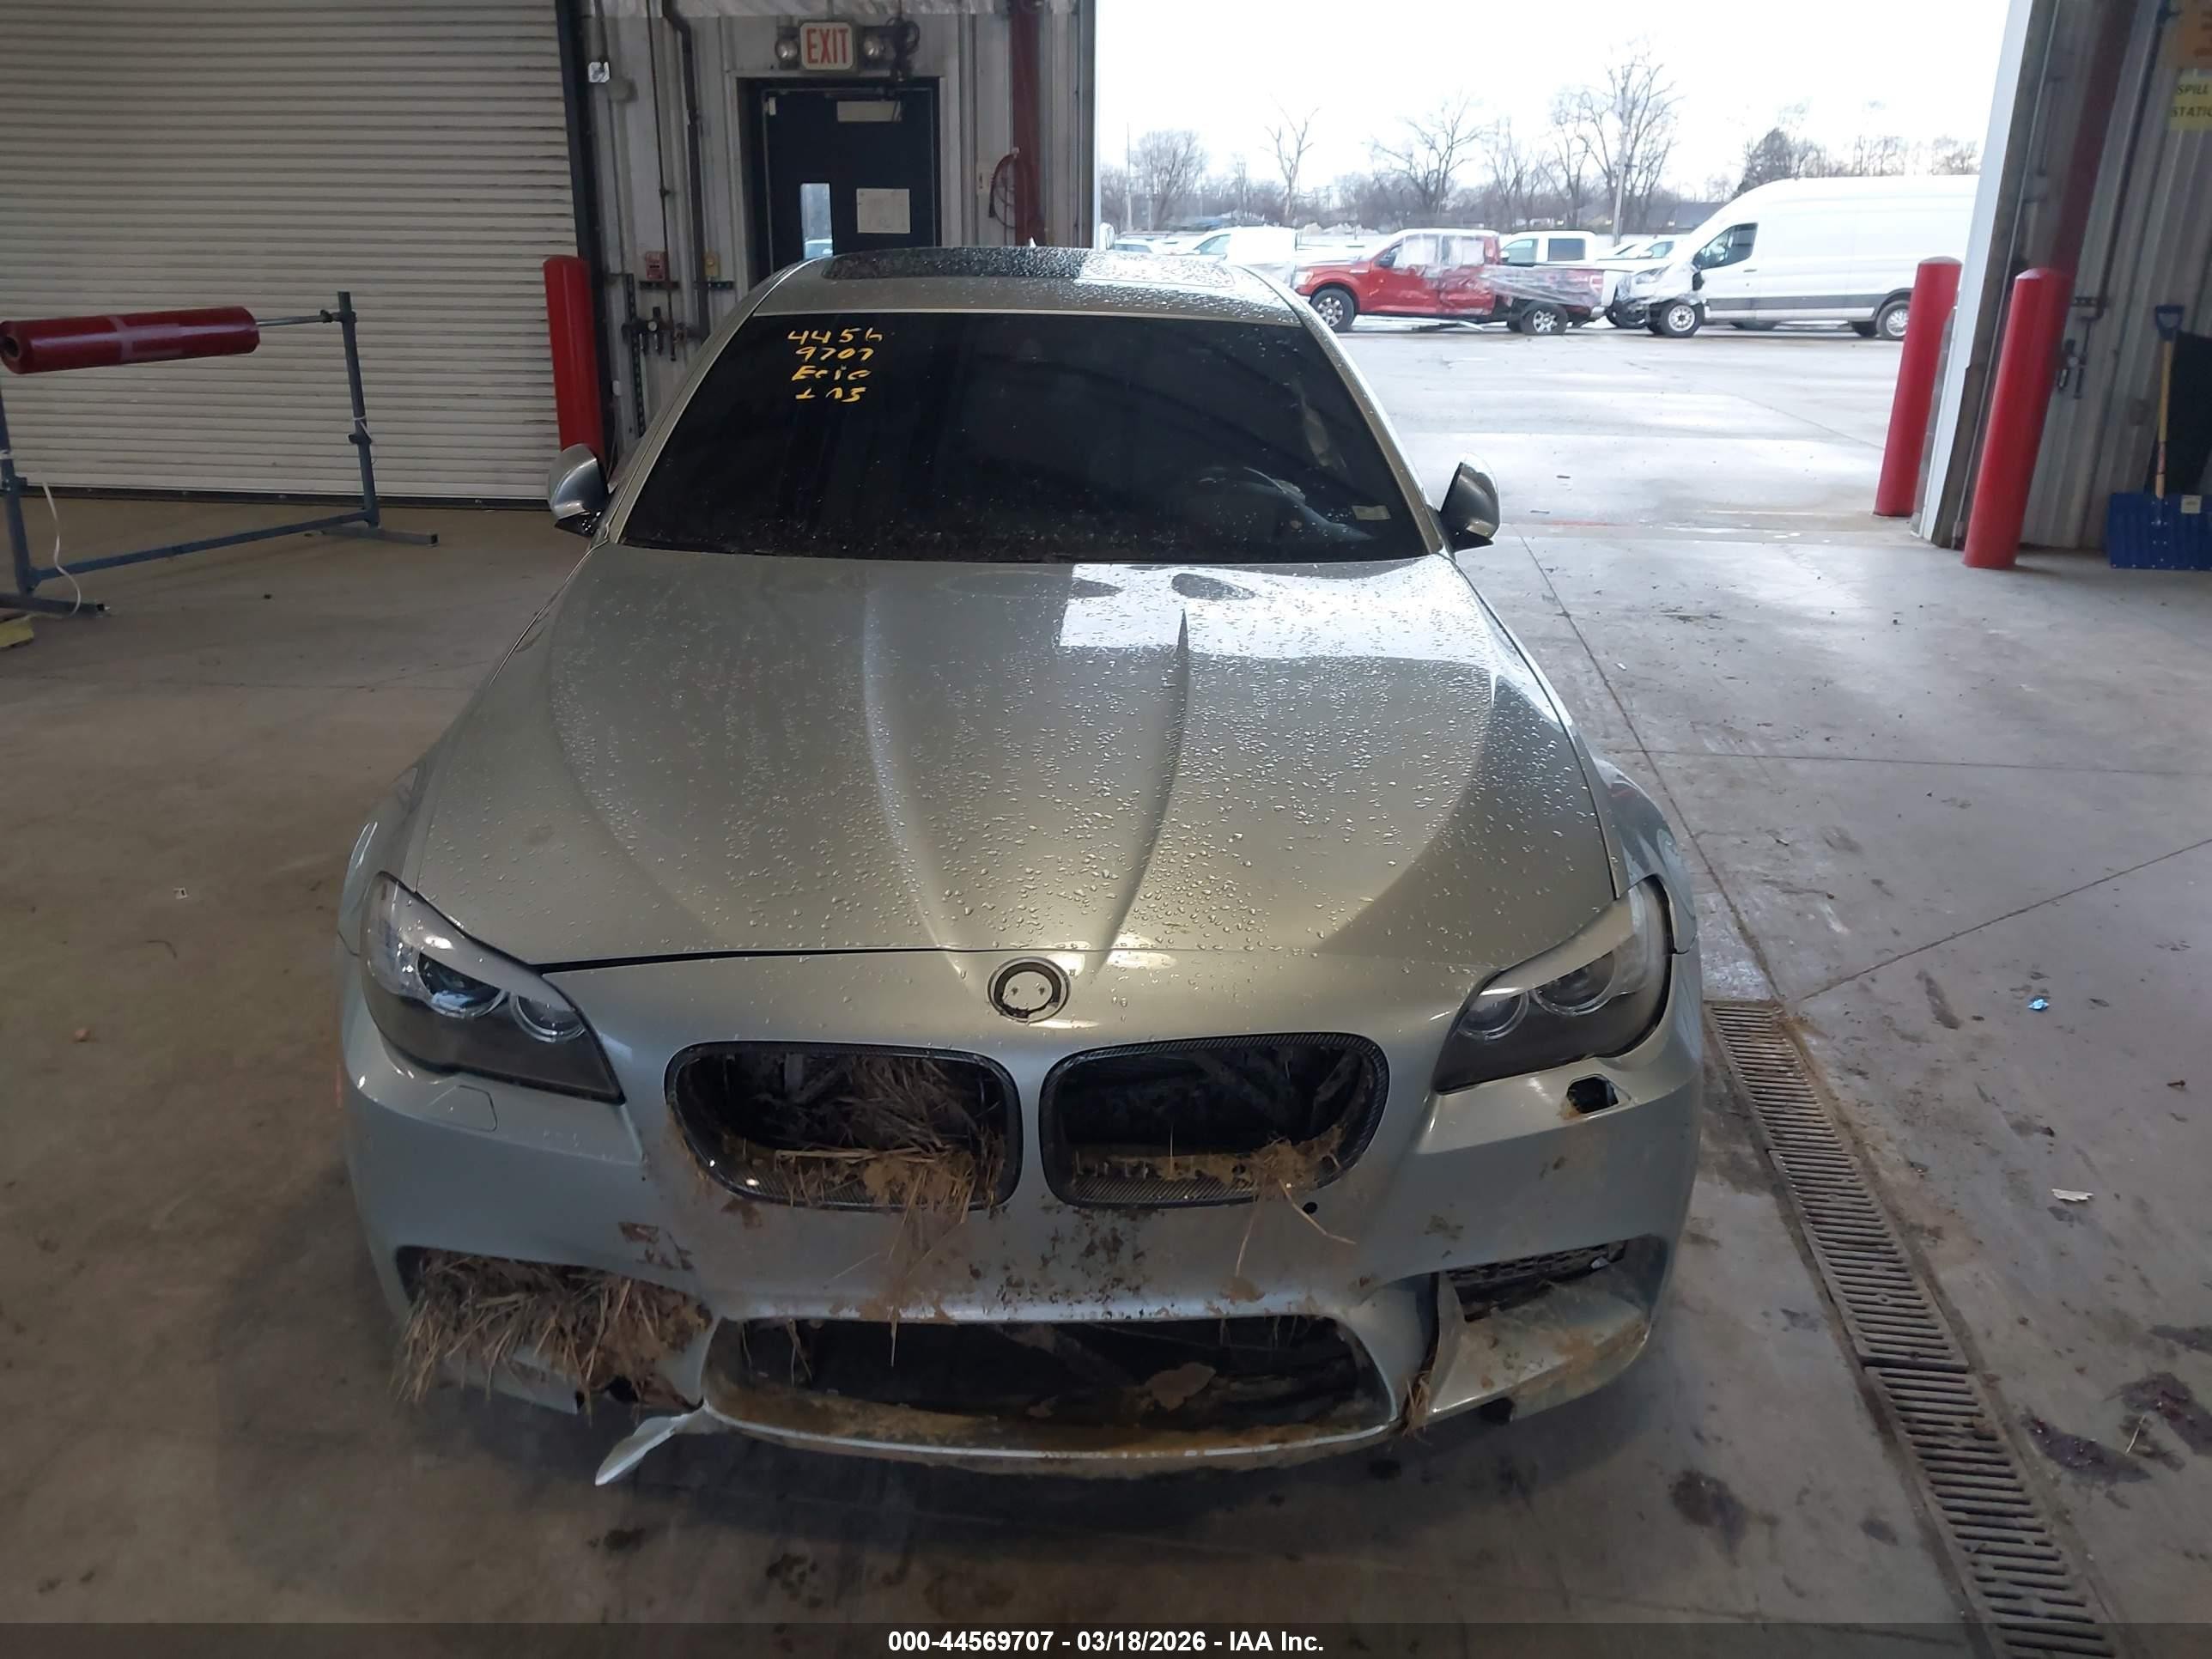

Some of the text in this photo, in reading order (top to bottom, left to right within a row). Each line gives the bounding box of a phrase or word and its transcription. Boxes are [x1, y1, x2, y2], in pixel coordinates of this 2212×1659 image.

[806, 27, 848, 64] EXIT
[2176, 83, 2209, 95] SPILL
[795, 346, 874, 362] 9707
